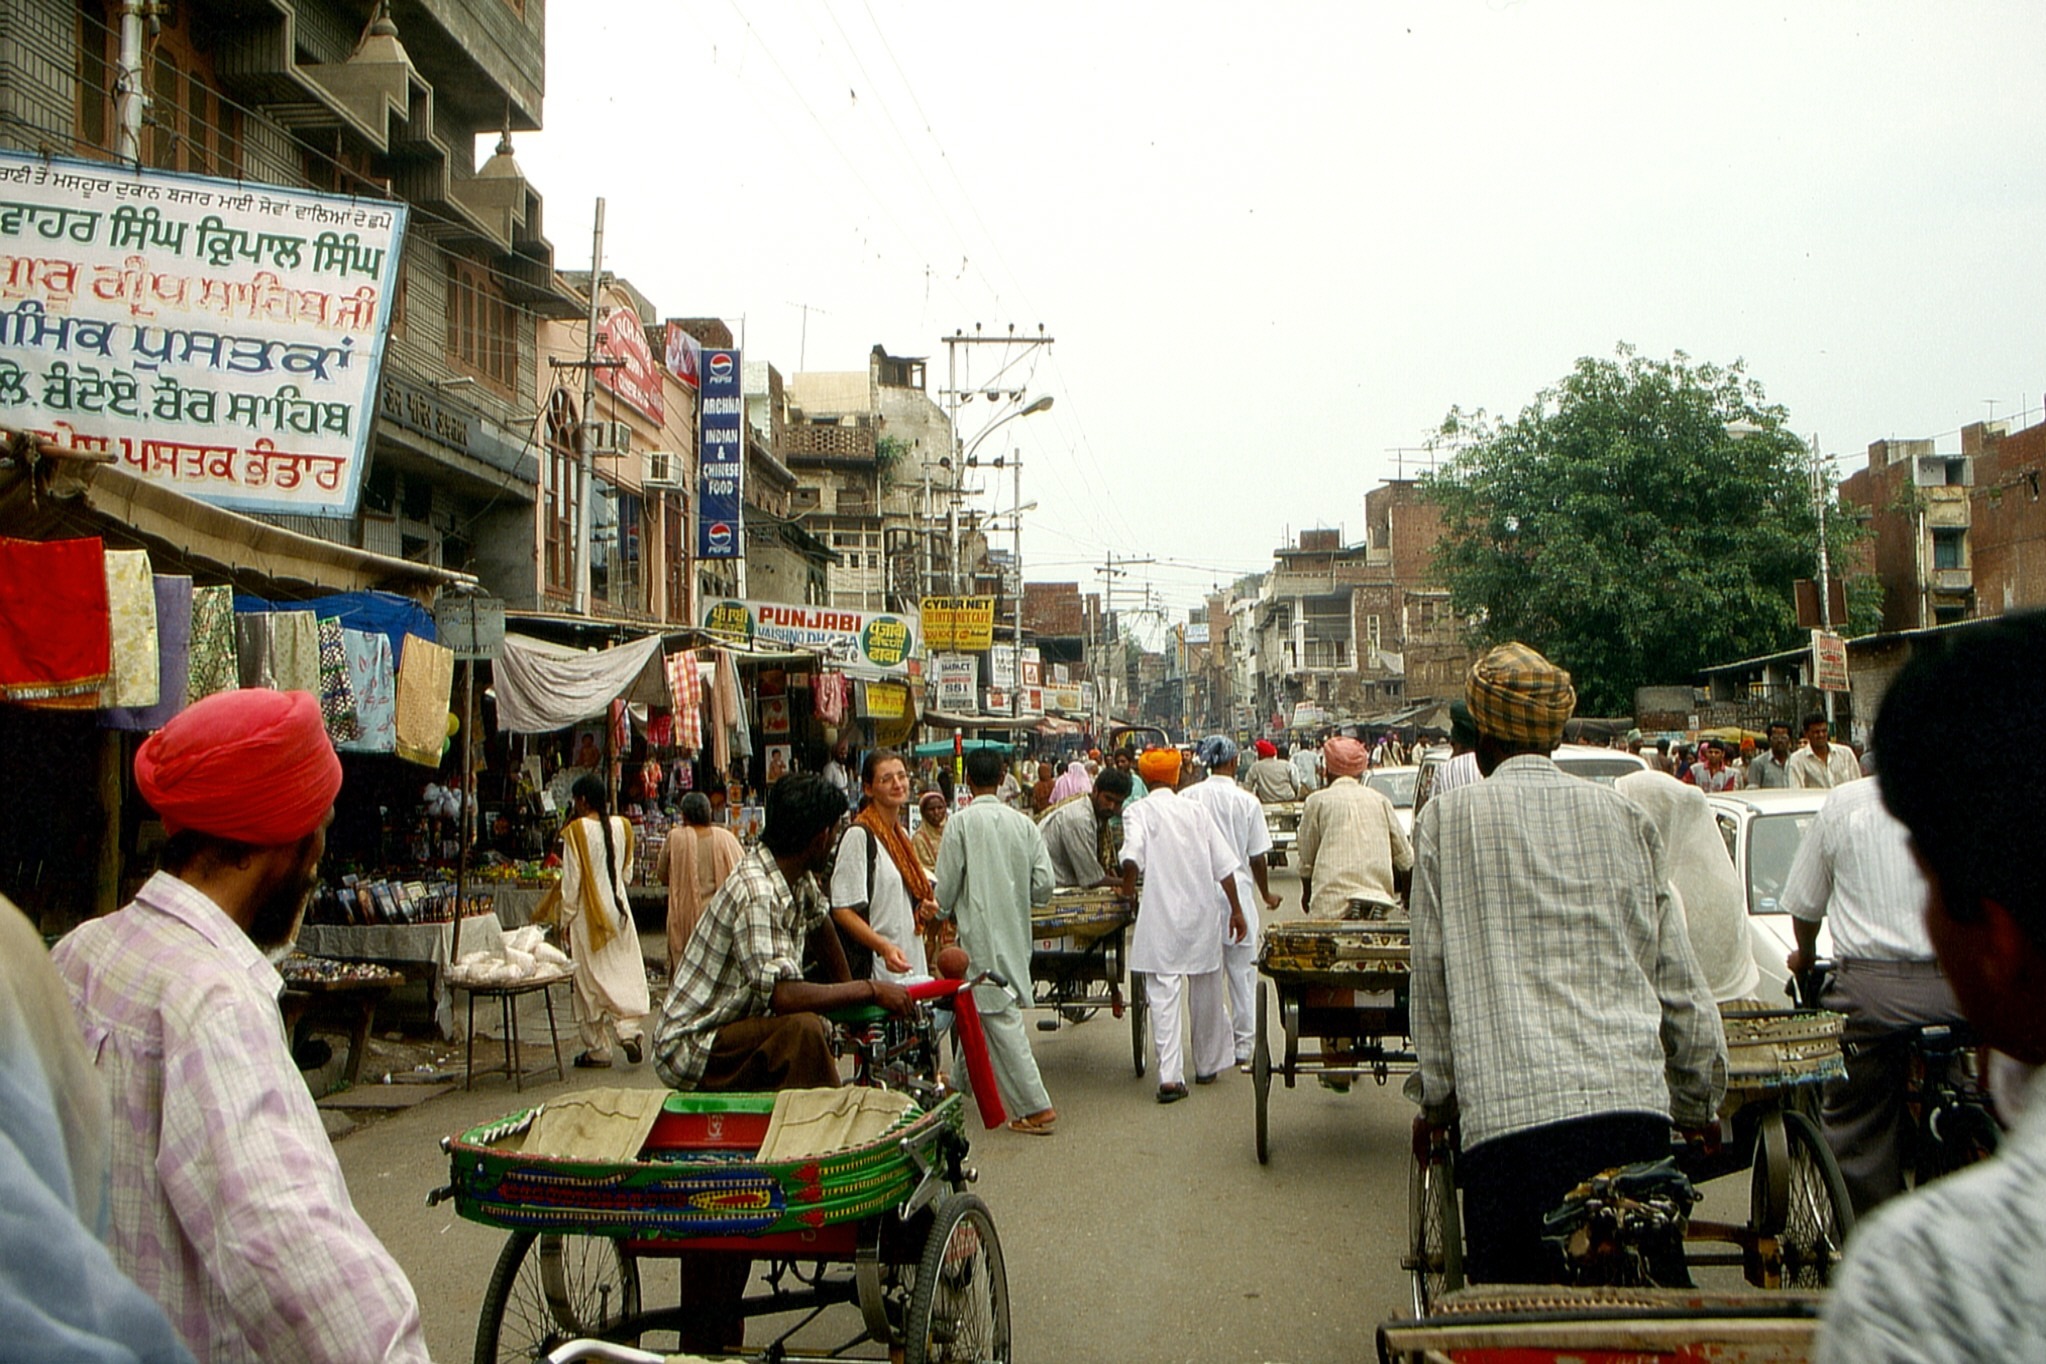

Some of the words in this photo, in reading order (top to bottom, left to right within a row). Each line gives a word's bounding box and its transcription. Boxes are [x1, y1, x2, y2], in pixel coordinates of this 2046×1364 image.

[116, 181, 162, 200] ਦੁਕਾਨ
[168, 188, 213, 206] ਬਜਾਰ
[218, 194, 253, 212] ਮਾਈ
[110, 206, 189, 255] ਸਿੰਘ
[313, 232, 385, 280] ਸਿੰਘ
[334, 286, 377, 329] ਜੀ
[130, 325, 355, 380] ਪੁਸਤਕਾਂ
[225, 385, 353, 437] ਸਾਹਿਬ
[703, 396, 740, 414] ARCHNA
[705, 428, 738, 444] INDIAN
[244, 437, 347, 490] ਭੰਡਾਰ
[717, 445, 725, 460] &
[703, 462, 739, 479] CHINESE
[708, 480, 734, 495] FOOD
[758, 606, 862, 632] PUNJABI
[758, 627, 804, 644] VAISHNO
